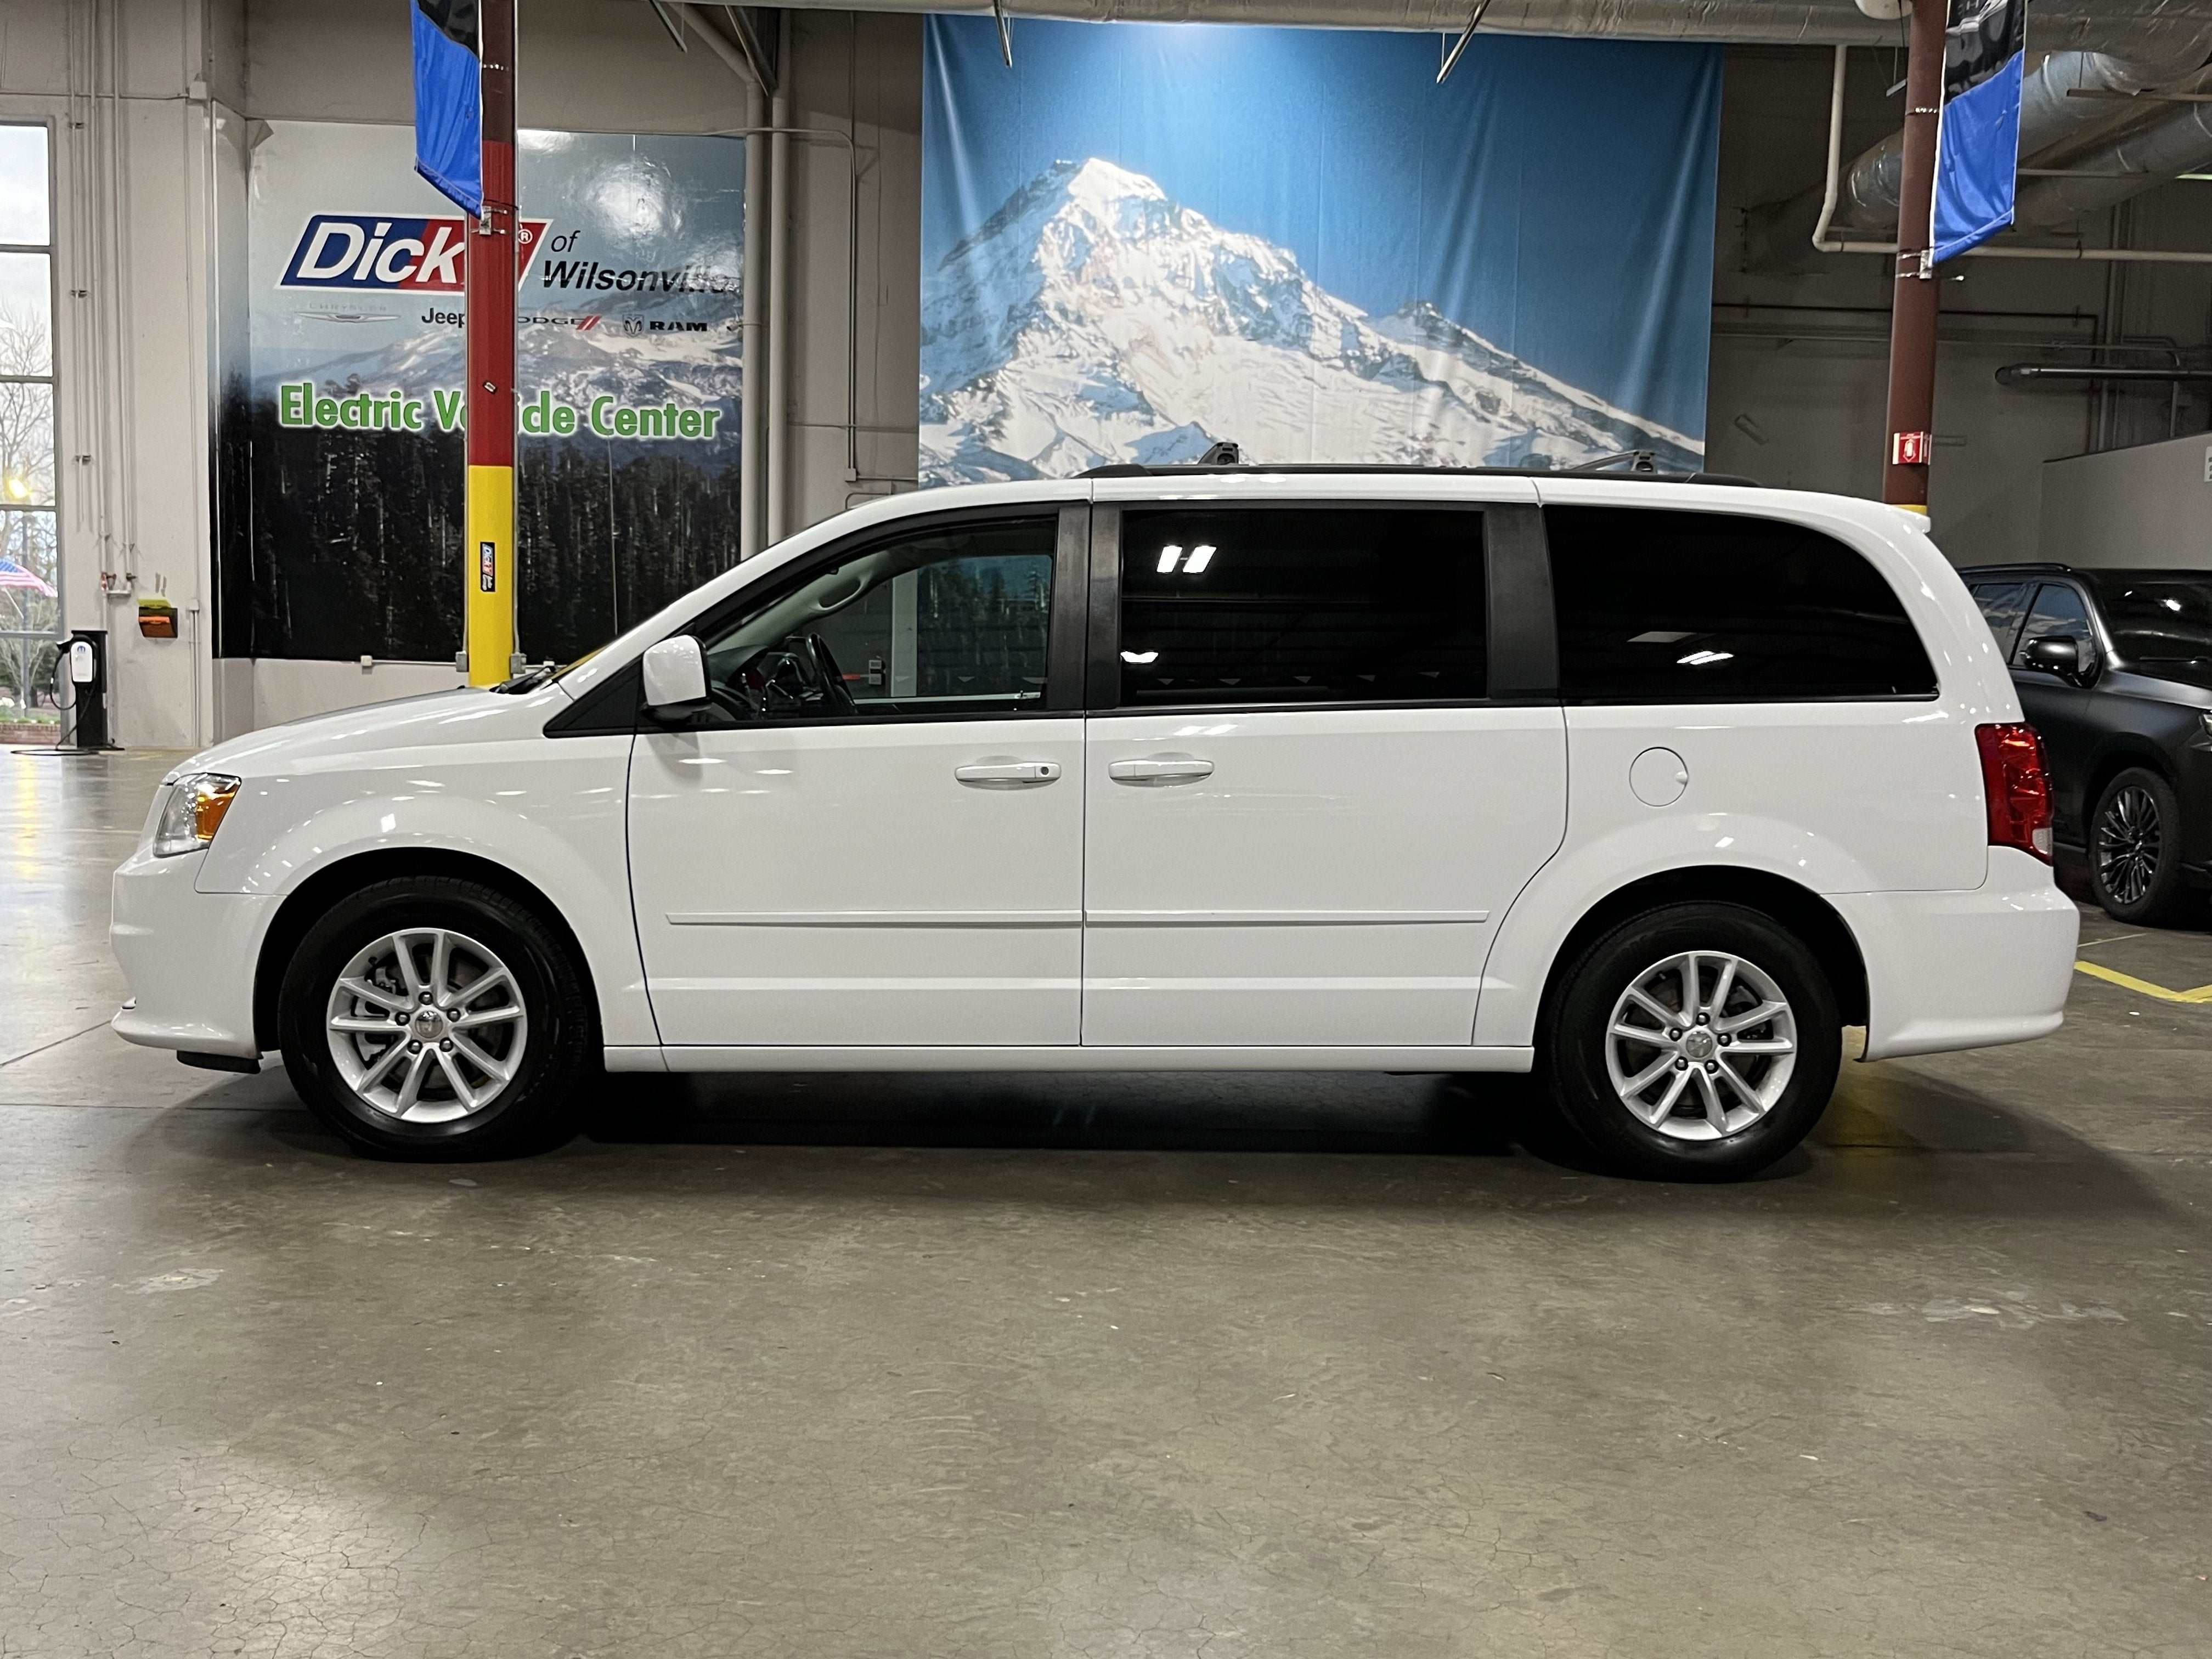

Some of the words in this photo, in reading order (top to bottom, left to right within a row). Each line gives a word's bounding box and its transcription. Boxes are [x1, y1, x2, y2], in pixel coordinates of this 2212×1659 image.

[297, 222, 465, 284] Dick
[551, 230, 581, 253] of
[543, 260, 727, 294] Wilsonvi
[421, 307, 465, 328] Jeep
[518, 317, 585, 325] ODGE
[650, 321, 707, 331] RAM
[281, 383, 422, 429] Electric
[433, 391, 575, 435] Vcle
[591, 396, 720, 437] Center
